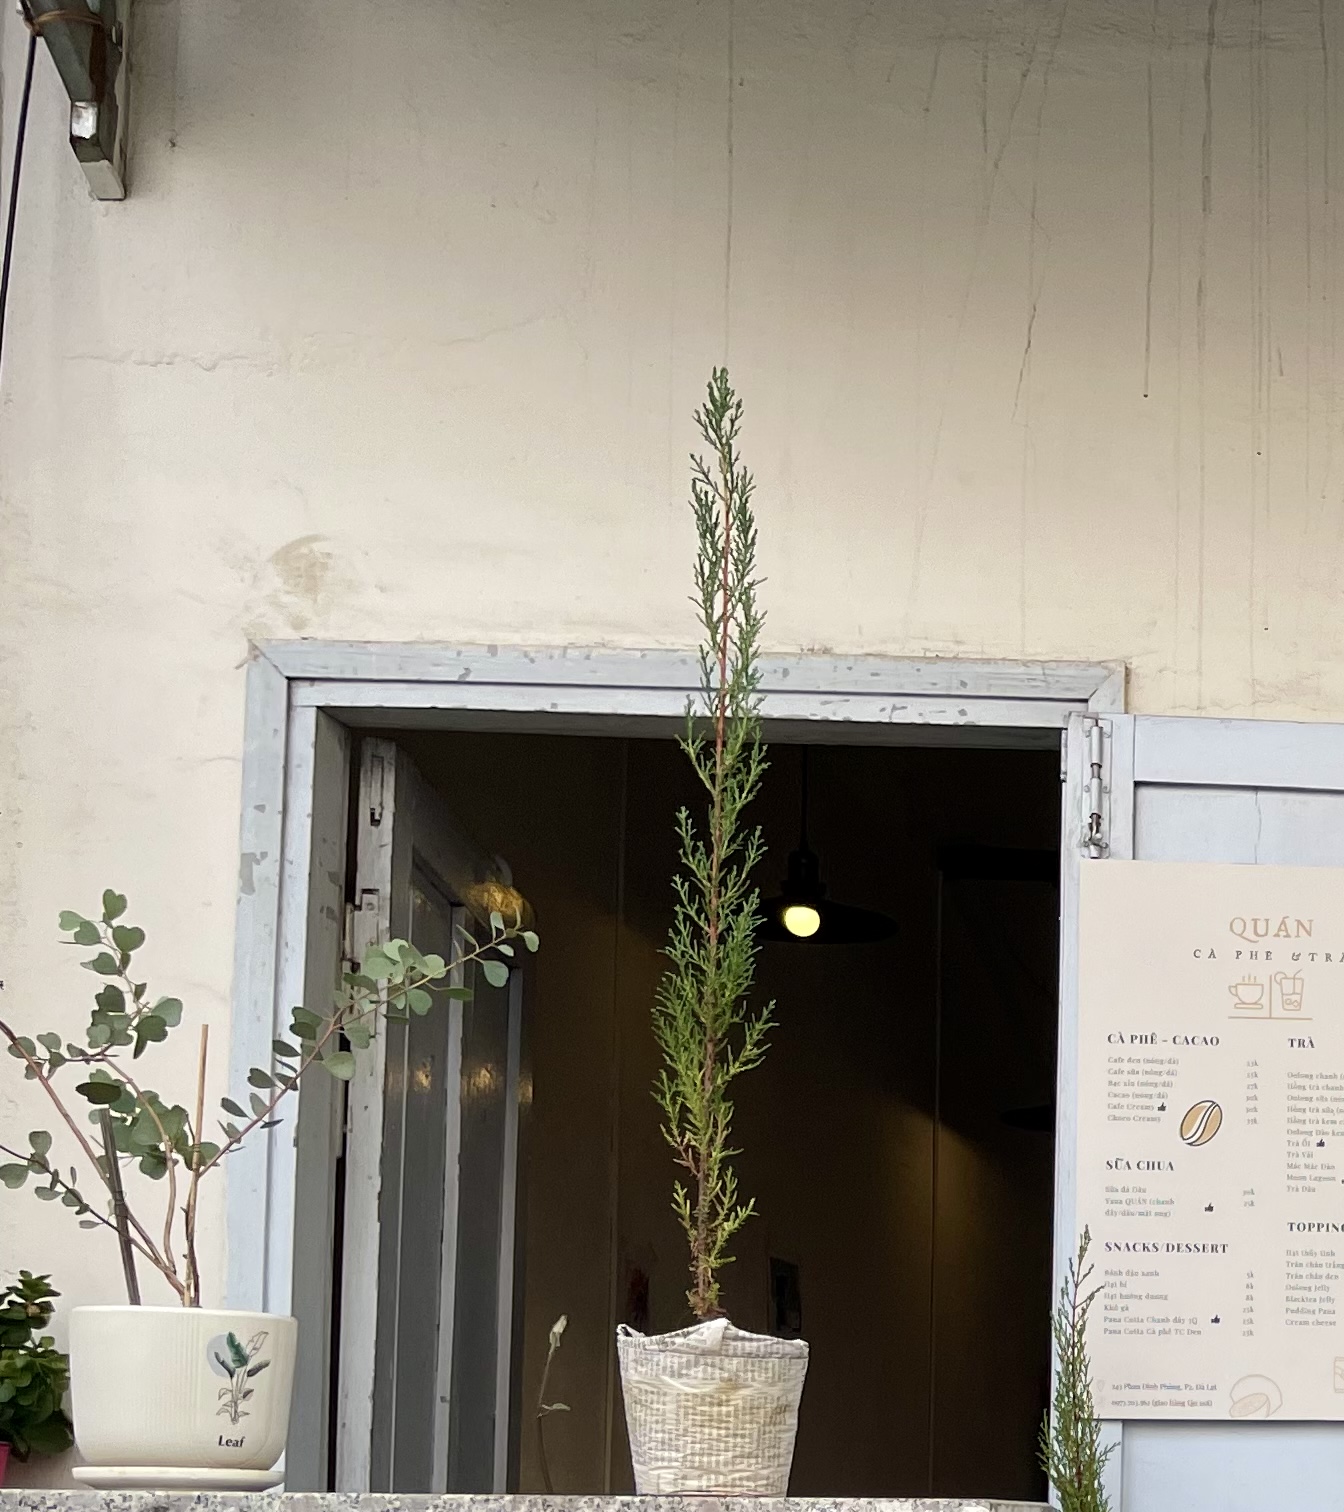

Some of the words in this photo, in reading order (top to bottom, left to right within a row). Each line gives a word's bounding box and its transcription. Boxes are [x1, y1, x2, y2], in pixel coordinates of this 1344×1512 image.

[1229, 916, 1314, 943] QUÁN
[1193, 948, 1217, 960] CÀ
[1107, 1031, 1125, 1044] CÀ
[1130, 1032, 1158, 1045] PHÊ
[1172, 1035, 1220, 1046] CACAO
[1287, 1036, 1315, 1049] TRÀ
[1106, 1157, 1132, 1171] SỮA
[1136, 1160, 1174, 1171] CHUA
[1104, 1241, 1229, 1254] SNACKS/DESSERT
[218, 1434, 246, 1448] Leaf
